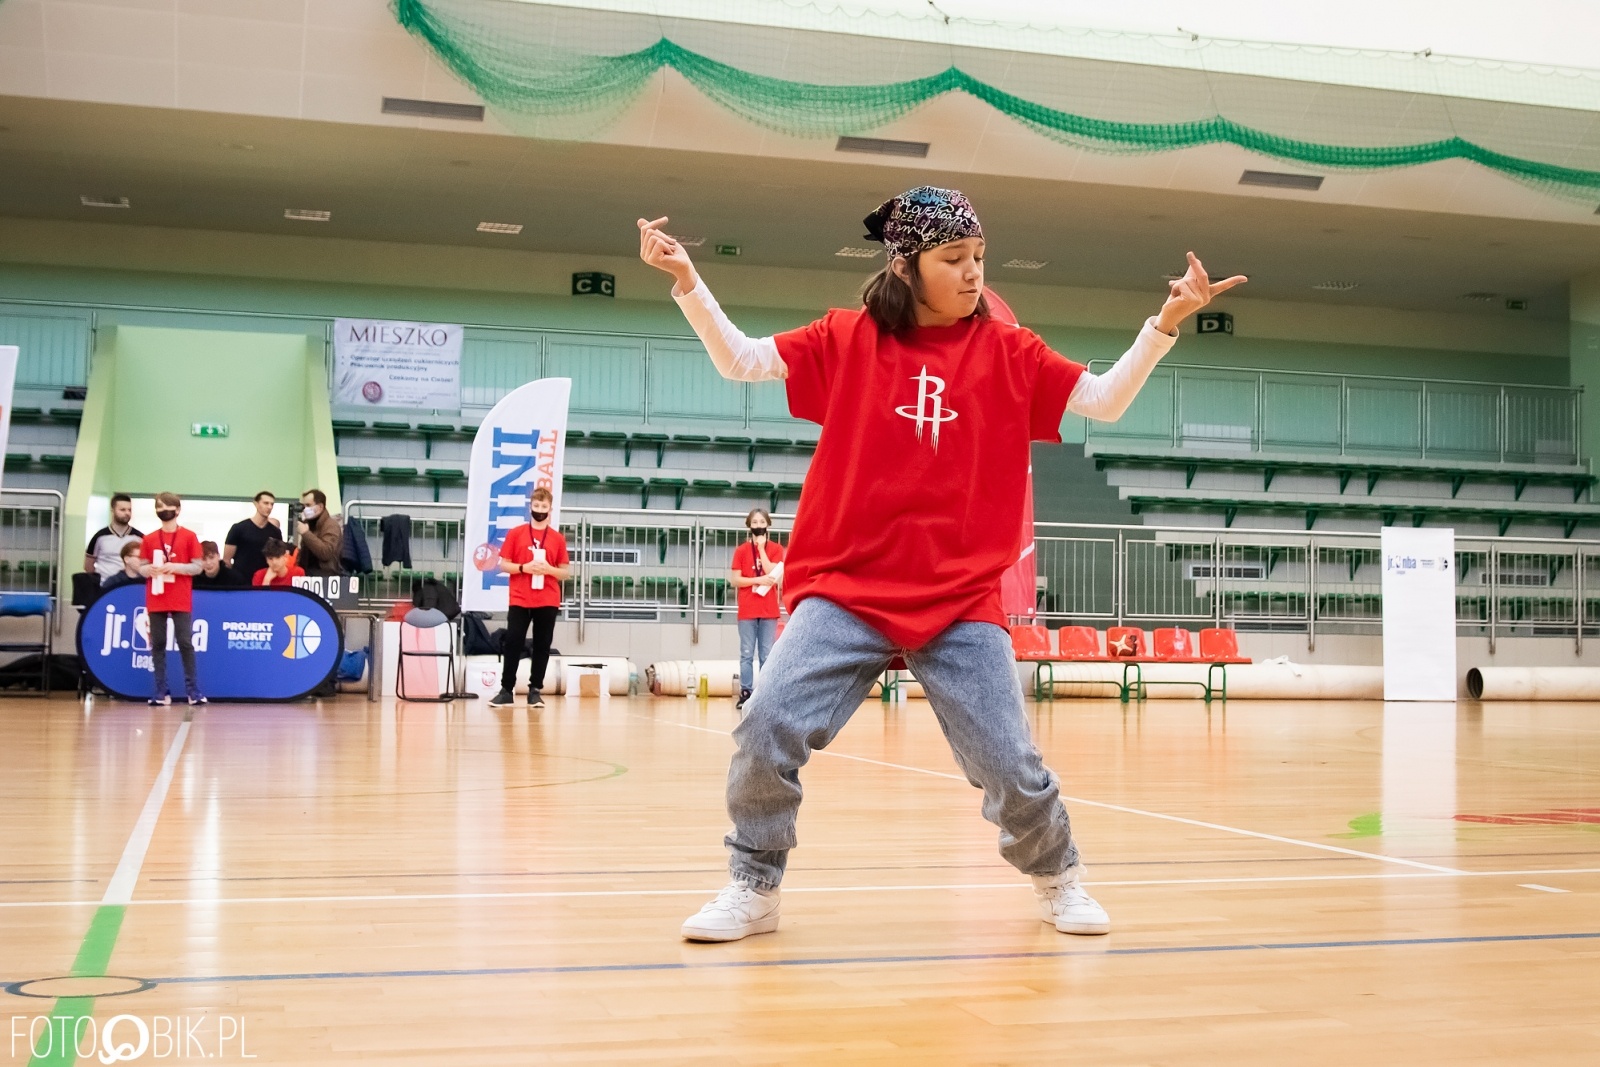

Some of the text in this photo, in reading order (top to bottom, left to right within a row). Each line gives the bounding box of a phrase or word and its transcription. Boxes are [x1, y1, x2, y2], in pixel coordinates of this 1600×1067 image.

[576, 279, 592, 292] C
[601, 280, 612, 294] C
[1202, 319, 1219, 331] D
[349, 325, 448, 347] MIESZKO
[100, 604, 130, 656] jr.
[222, 621, 274, 632] PROJEKT
[227, 631, 273, 641] BASKET
[227, 640, 272, 651] POLSKA
[132, 652, 155, 672] Leag
